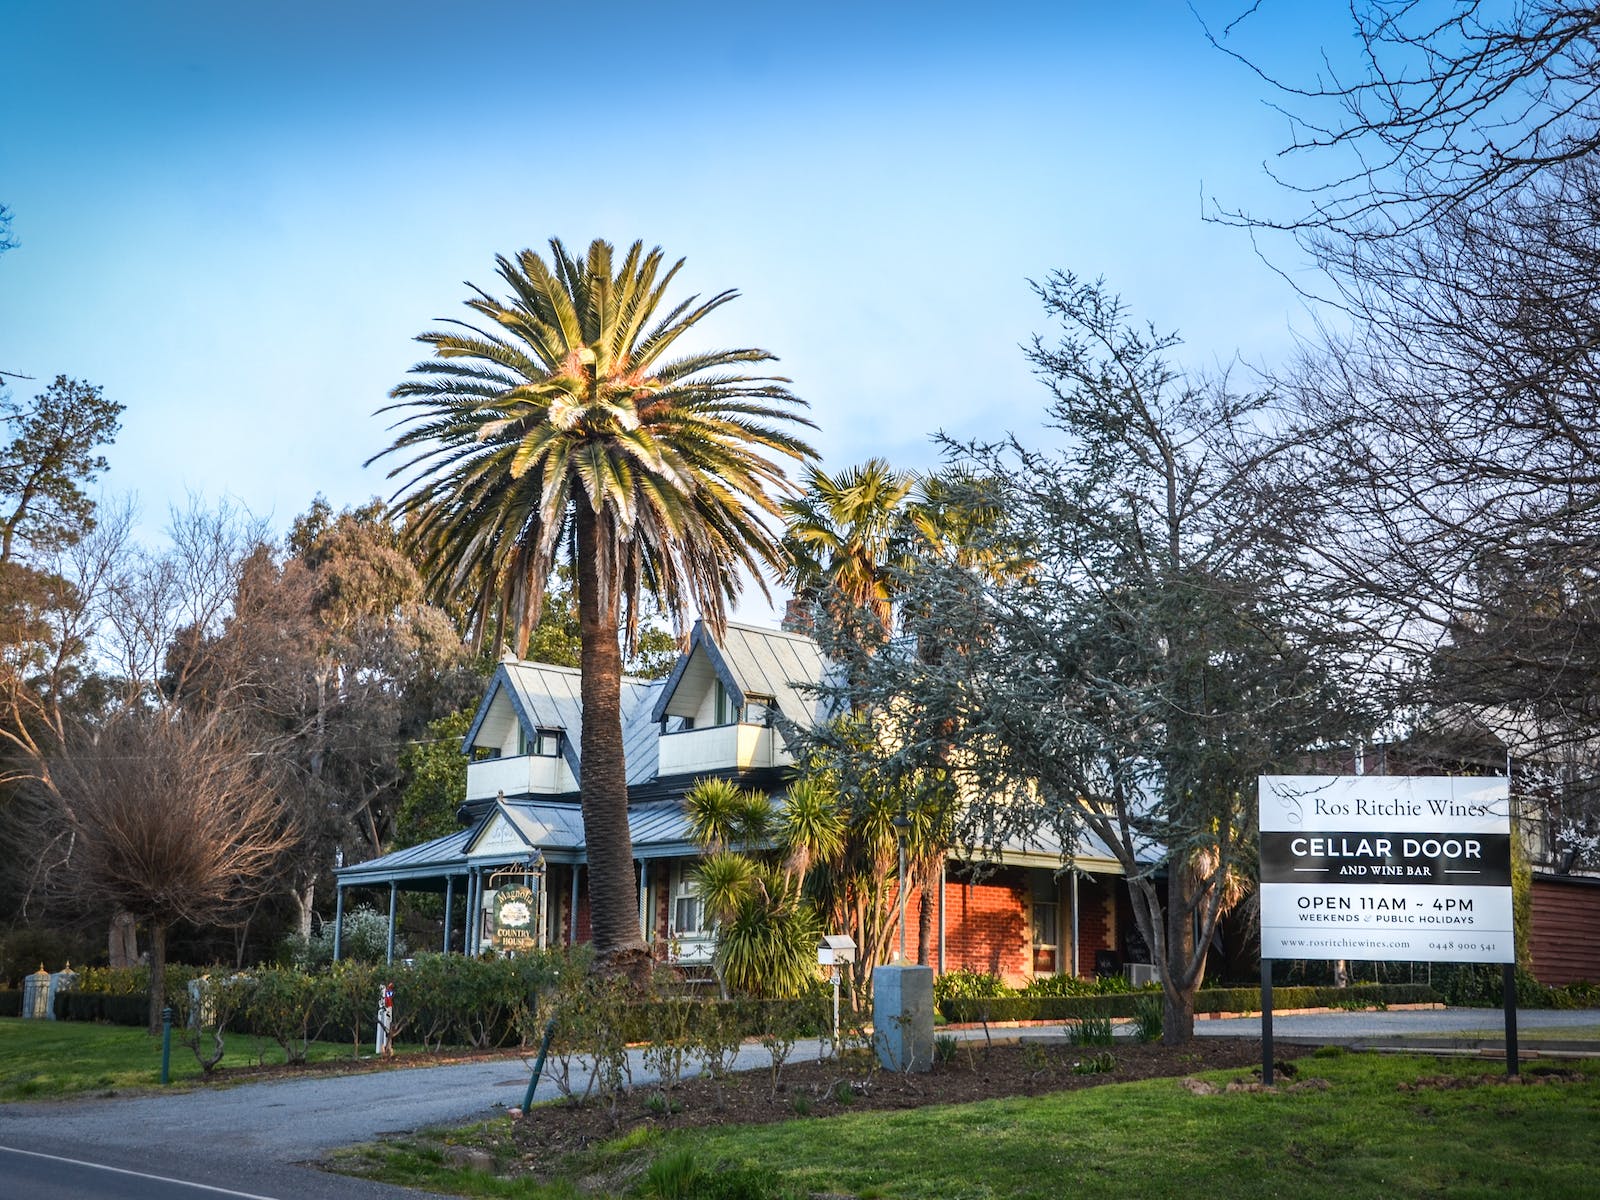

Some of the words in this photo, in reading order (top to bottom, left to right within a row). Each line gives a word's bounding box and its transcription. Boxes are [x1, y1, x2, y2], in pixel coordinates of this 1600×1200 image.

[1314, 798, 1350, 816] Ros
[1356, 798, 1422, 816] Ritchie
[1426, 799, 1486, 817] Wines
[1290, 837, 1393, 858] CELLAR
[1402, 838, 1482, 859] DOOR
[1339, 865, 1369, 876] AND
[1370, 865, 1404, 877] WINE
[1406, 865, 1433, 877] BAR
[497, 890, 534, 905] Magnolia
[1297, 896, 1351, 910] OPEN
[1359, 897, 1407, 911] 11AM
[1432, 898, 1474, 912] 4PM
[1298, 913, 1361, 923] WEEKENDS
[1363, 914, 1372, 923] &
[1376, 914, 1415, 924] PUBLIC
[1419, 915, 1475, 925] HOLIDAYS
[497, 929, 531, 937] COUNTRY
[1280, 938, 1410, 948] www.rosritchiewines.com
[1428, 941, 1455, 951] 0448
[1457, 943, 1478, 952] 900
[1480, 943, 1496, 952] 541
